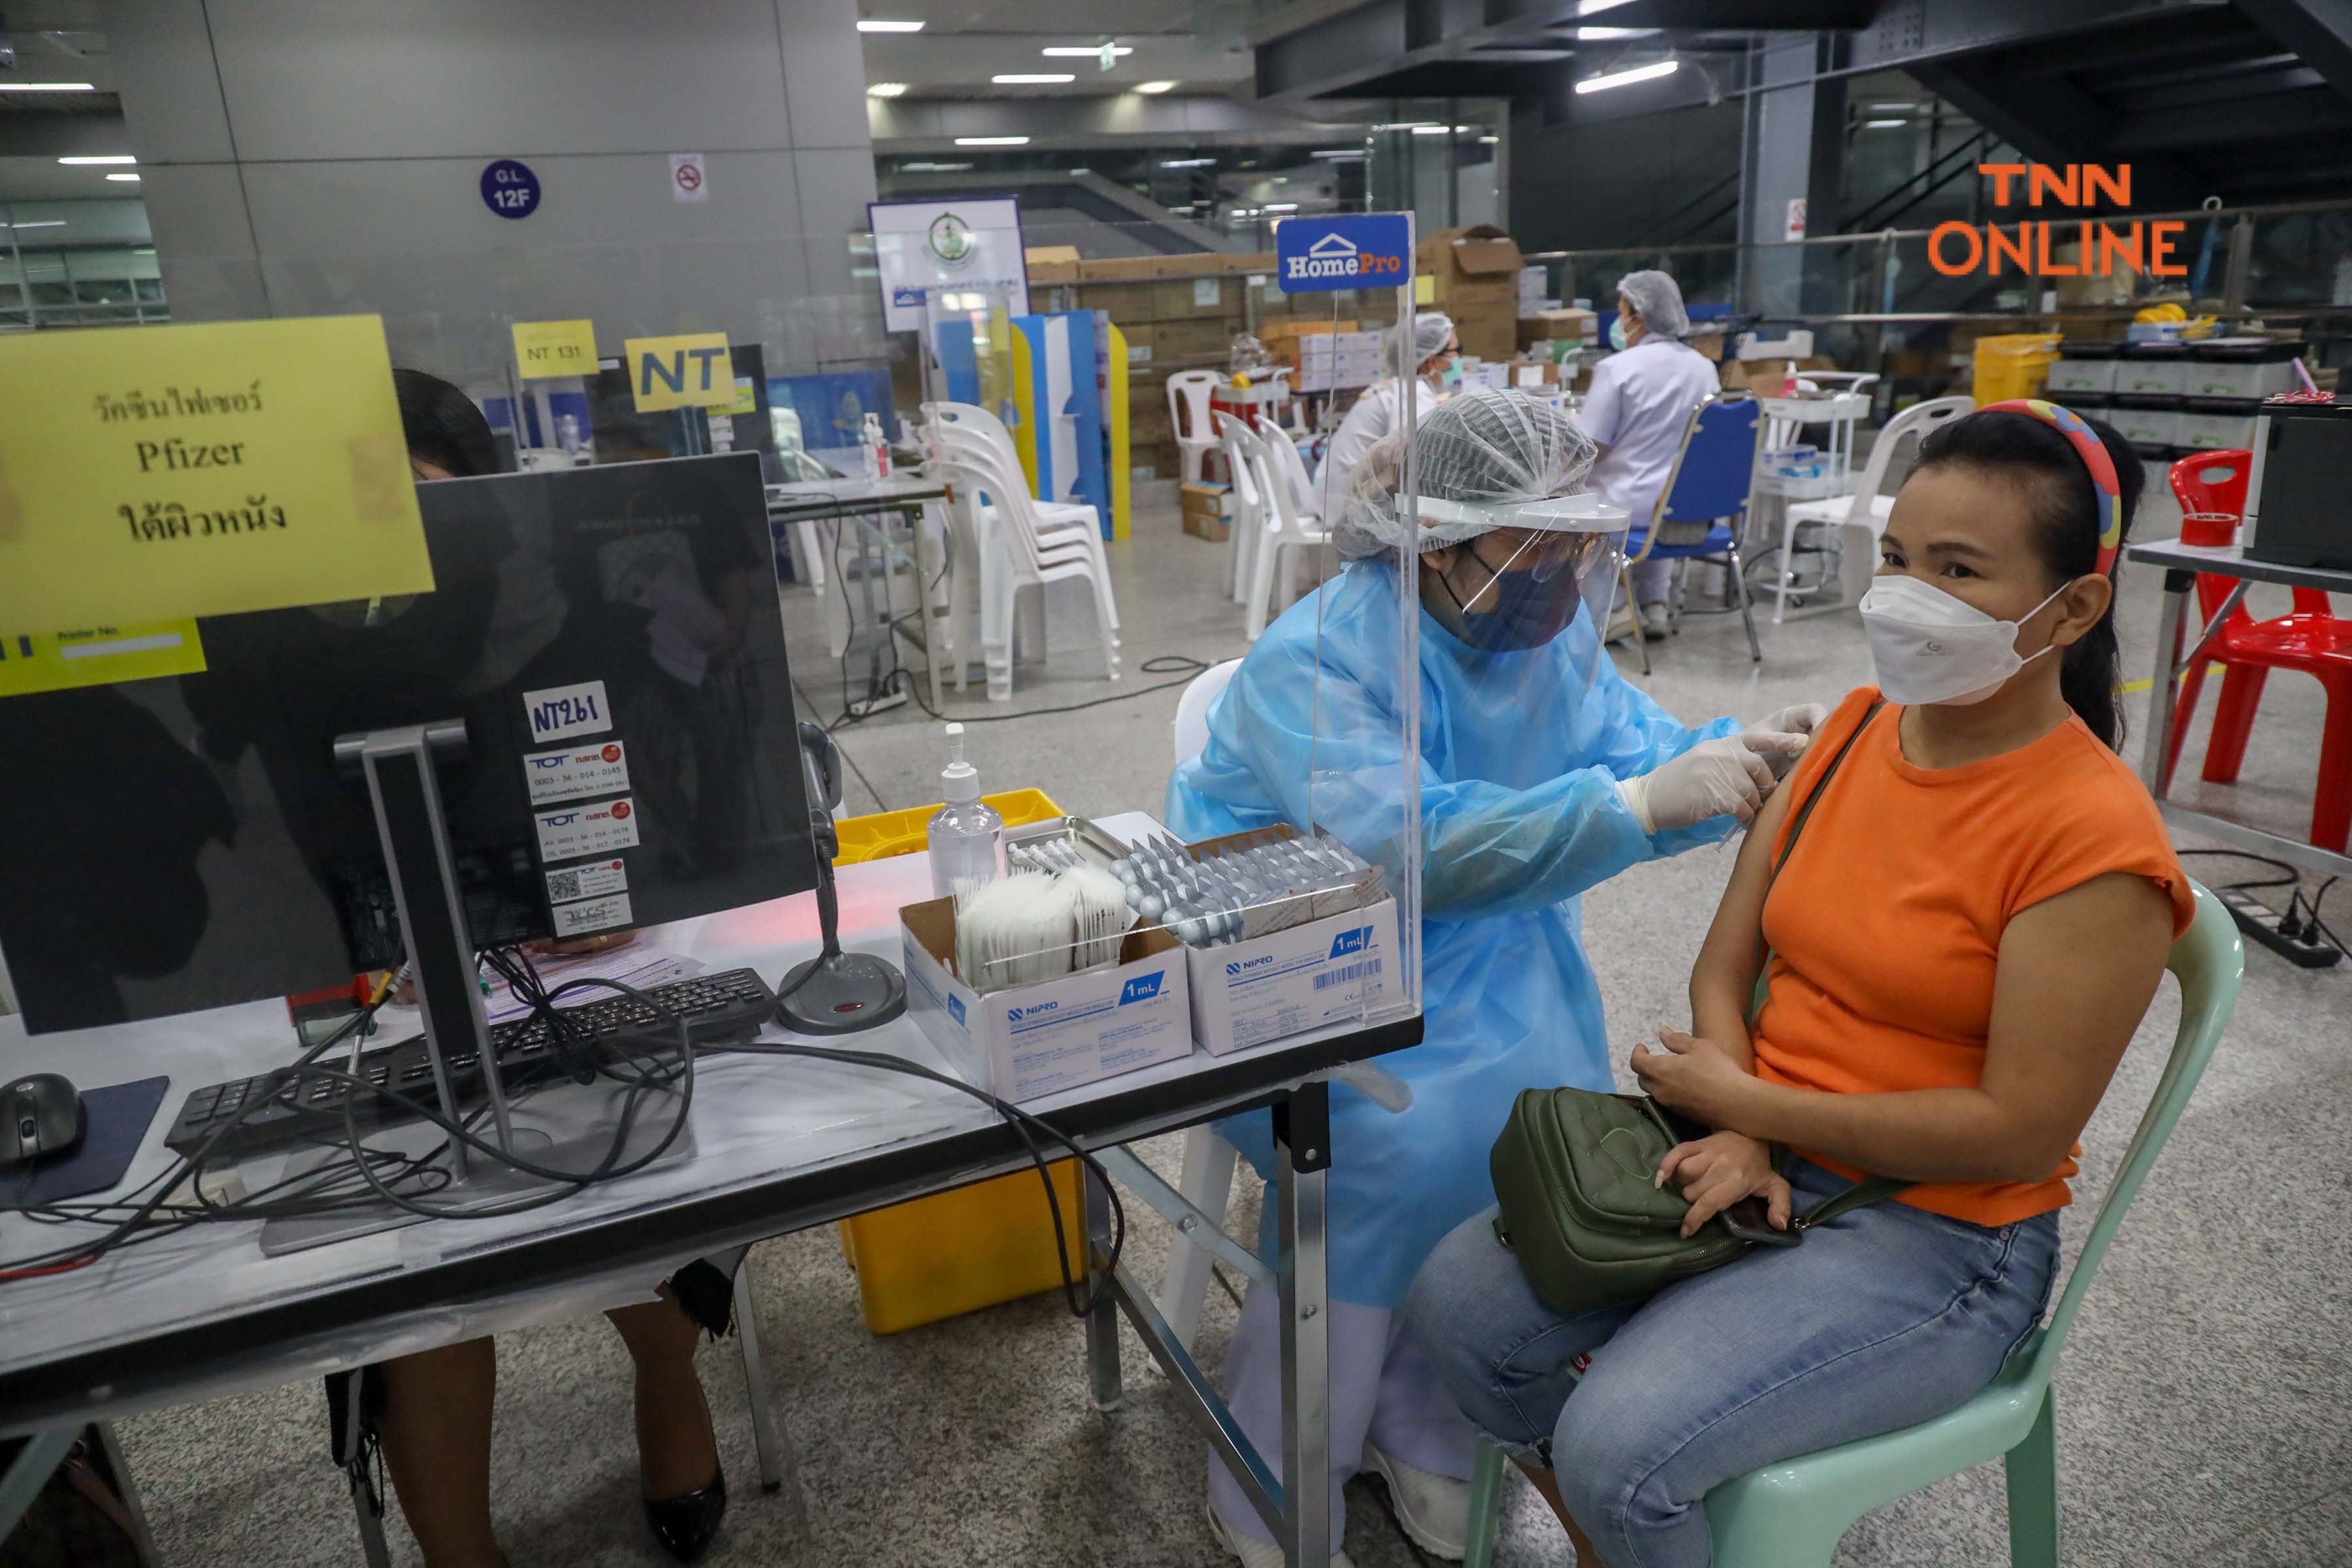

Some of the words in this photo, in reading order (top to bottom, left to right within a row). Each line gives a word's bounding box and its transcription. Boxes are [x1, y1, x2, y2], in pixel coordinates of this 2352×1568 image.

[493, 188, 531, 208] 12F
[1286, 253, 1401, 279] HomePro
[527, 347, 549, 360] NT
[559, 346, 581, 359] 131
[640, 348, 725, 396] NT
[95, 379, 263, 423] วัคซีนไฟเซอร์
[136, 437, 245, 472] Pfizer
[117, 494, 287, 542] ใต้ผิวหนัง
[533, 694, 598, 732] NT261
[529, 755, 570, 769] TOT
[540, 812, 580, 827] TOT
[1337, 937, 1344, 950] 1
[1347, 936, 1362, 948] mL
[1243, 955, 1273, 970] NIPRO
[1127, 983, 1134, 998] 1
[1137, 983, 1155, 995] mL
[1026, 1001, 1058, 1016] NIPRO
